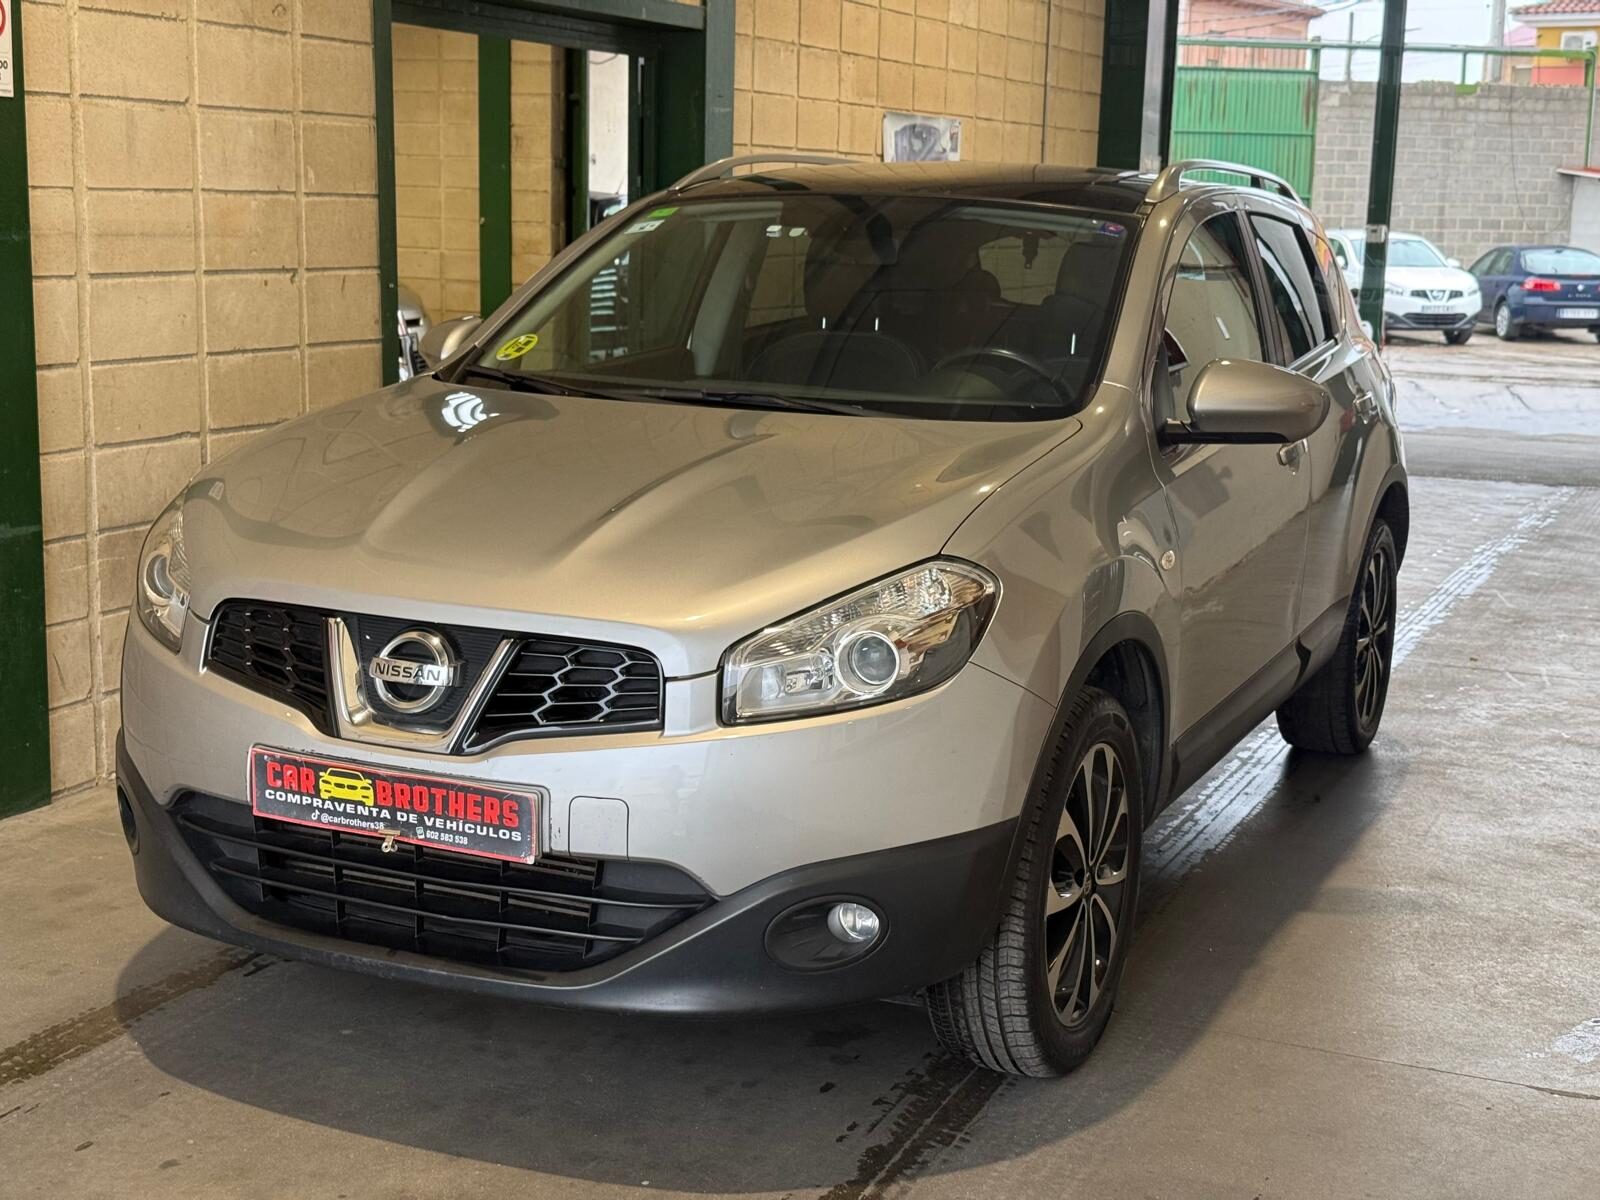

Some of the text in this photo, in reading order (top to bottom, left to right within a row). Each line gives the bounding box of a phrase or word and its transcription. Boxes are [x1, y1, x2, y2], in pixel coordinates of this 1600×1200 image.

[374, 662, 441, 682] NISSAN
[265, 789, 522, 842] COMPRAVENTA DE VEHÍCULOS
[266, 761, 519, 828] CAR BROTHERS
